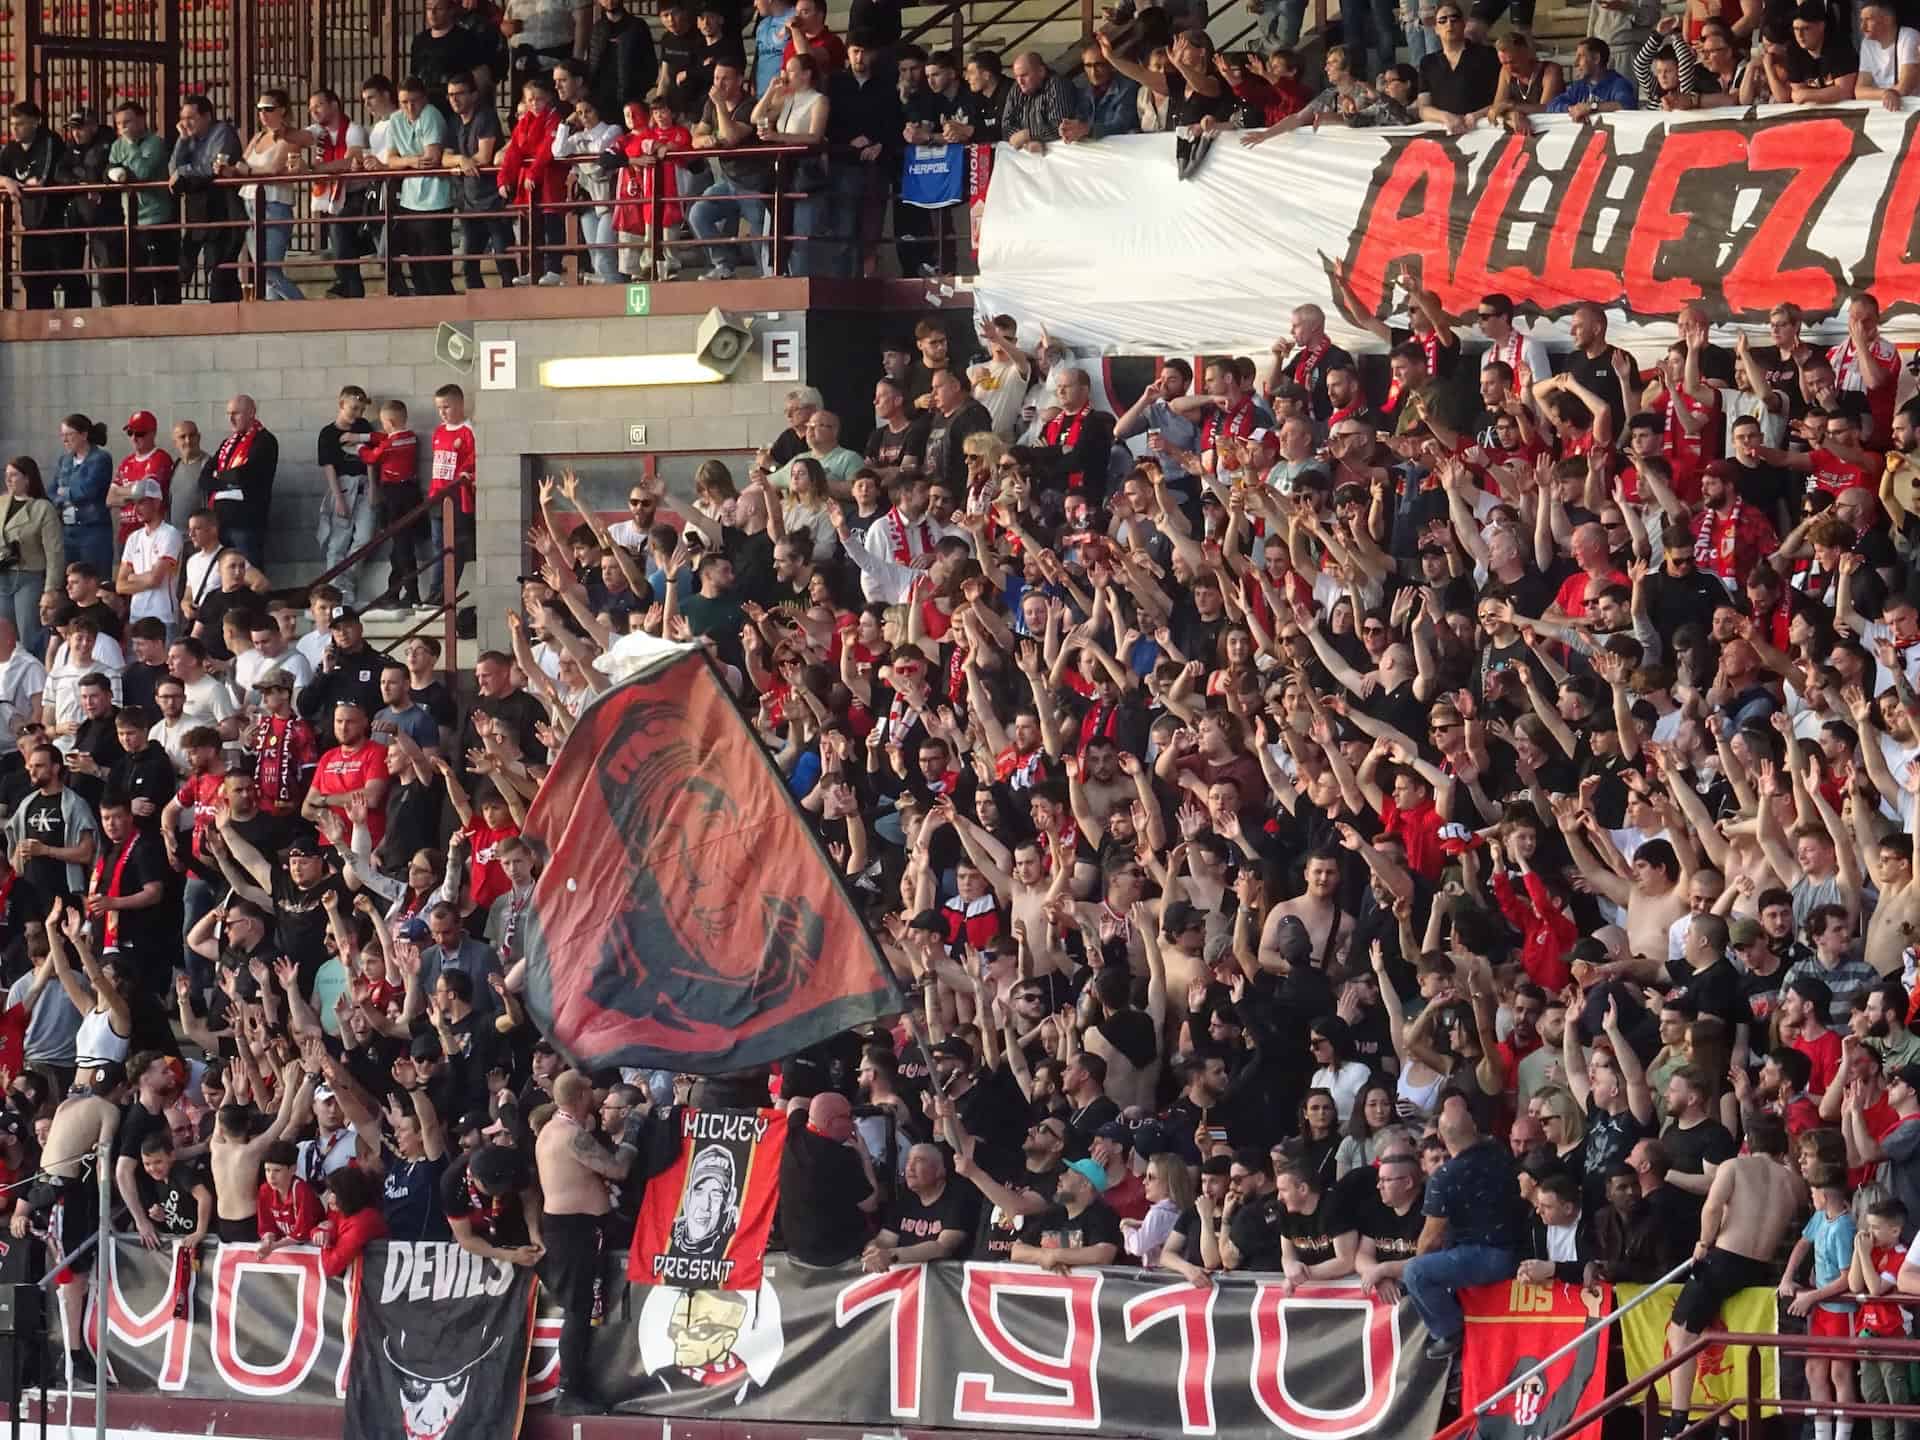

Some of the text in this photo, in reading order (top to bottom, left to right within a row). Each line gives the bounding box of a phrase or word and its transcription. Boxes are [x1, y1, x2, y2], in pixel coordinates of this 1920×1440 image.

[1346, 113, 1858, 320] ALLEZ
[489, 348, 507, 382] F
[772, 339, 791, 373] E
[683, 1112, 769, 1142] MICKEY
[380, 1240, 515, 1304] DEVILS
[652, 1254, 734, 1282] PRESENT
[835, 1262, 1401, 1440] 1910
